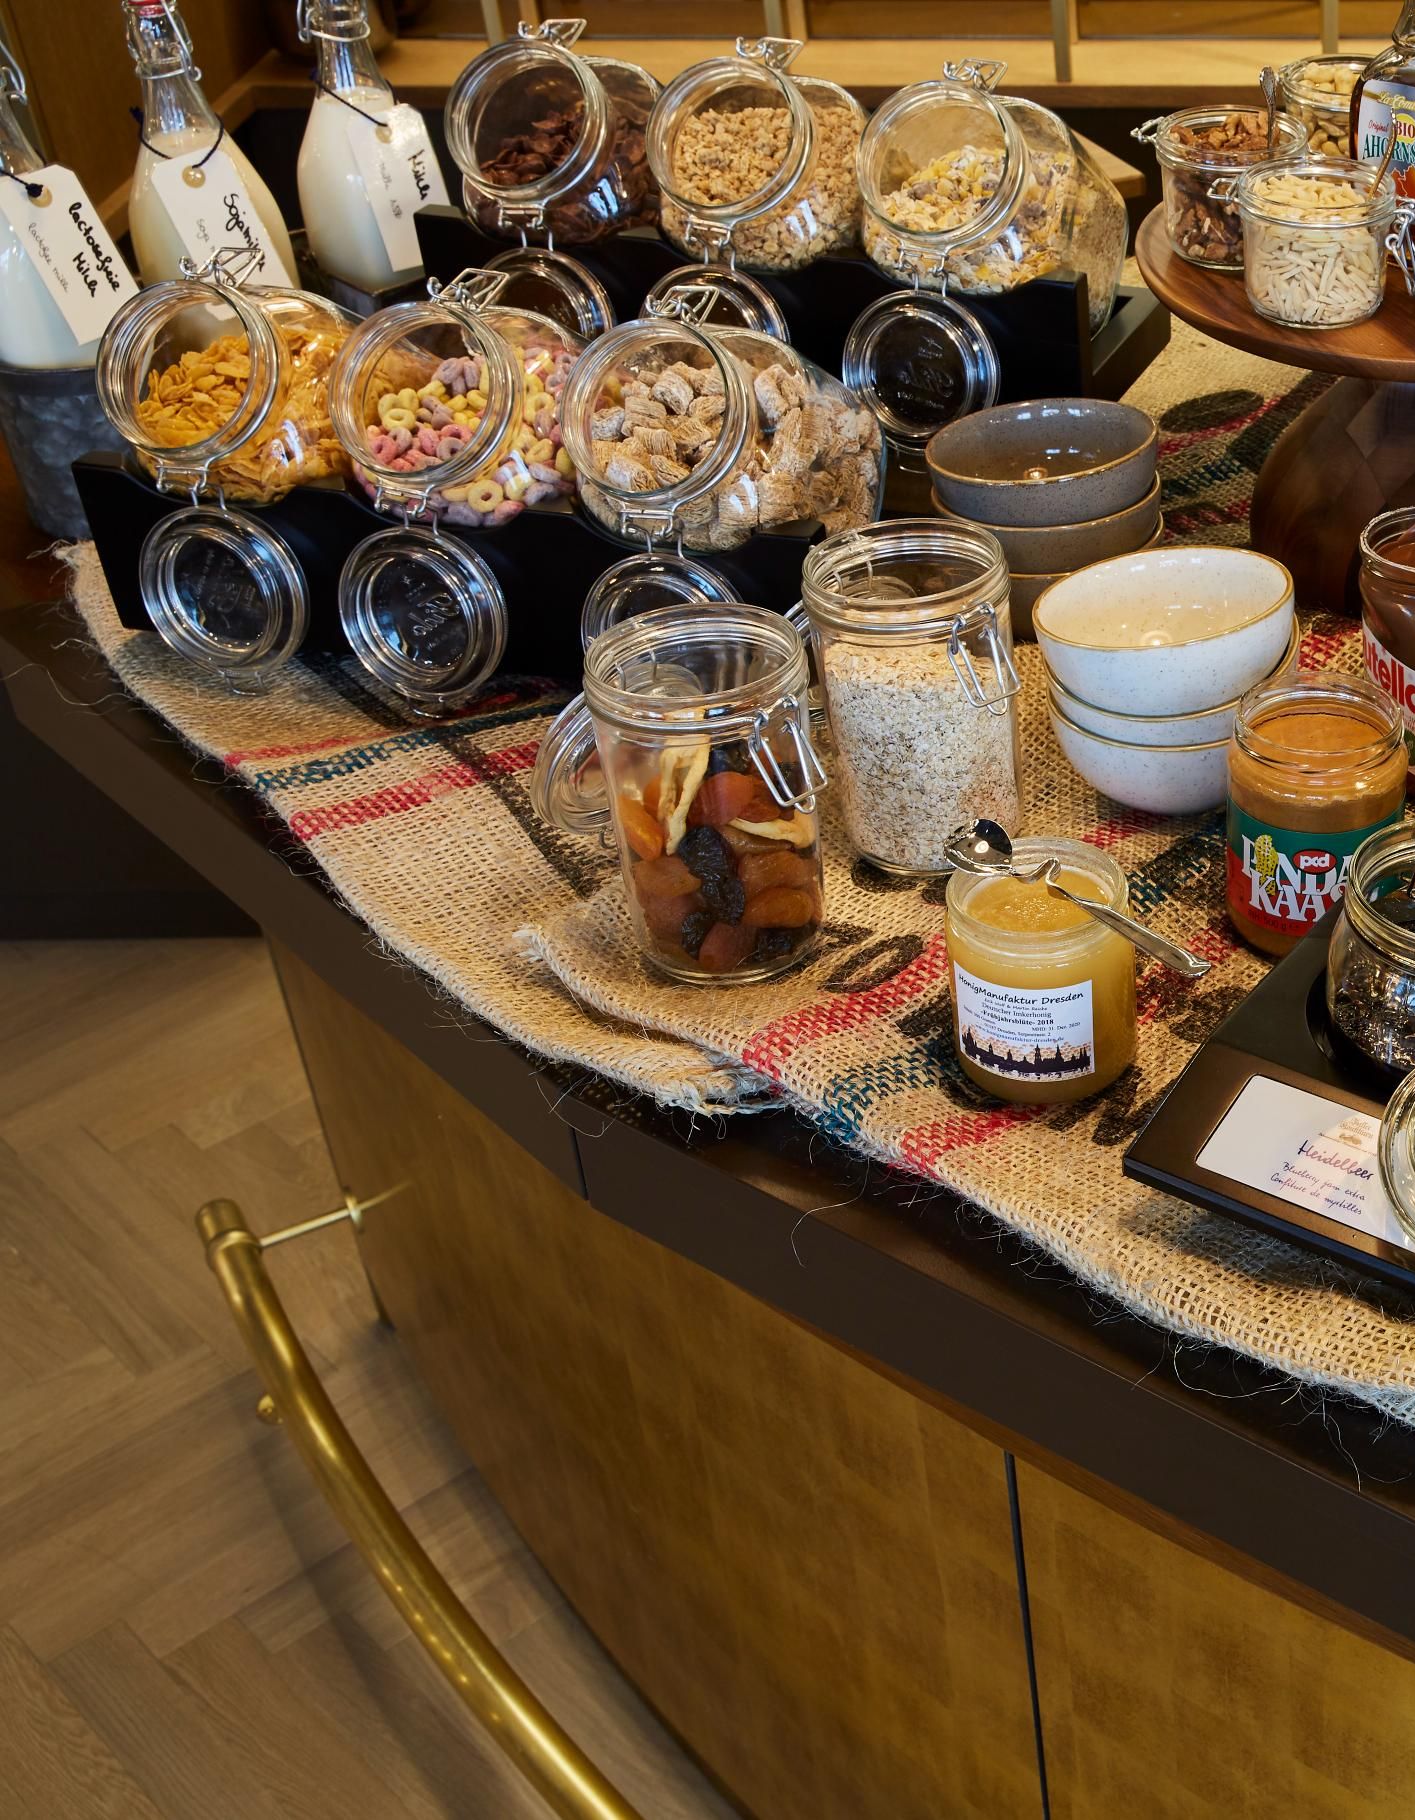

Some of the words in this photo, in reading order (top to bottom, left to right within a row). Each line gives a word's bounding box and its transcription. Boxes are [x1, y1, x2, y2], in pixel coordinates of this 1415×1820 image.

[68, 202, 119, 293] lactosefreie
[73, 251, 96, 298] Milch
[958, 974, 1038, 1005] HonigManufaktur
[1041, 992, 1084, 1005] Dresden
[1013, 1010, 1052, 1018] Imkerhonig
[1270, 1173, 1307, 1193] Confiture
[1309, 1187, 1321, 1199] de
[1323, 1196, 1363, 1216] myrtilles
[1322, 1180, 1341, 1195] jam
[1344, 1188, 1366, 1201] extra
